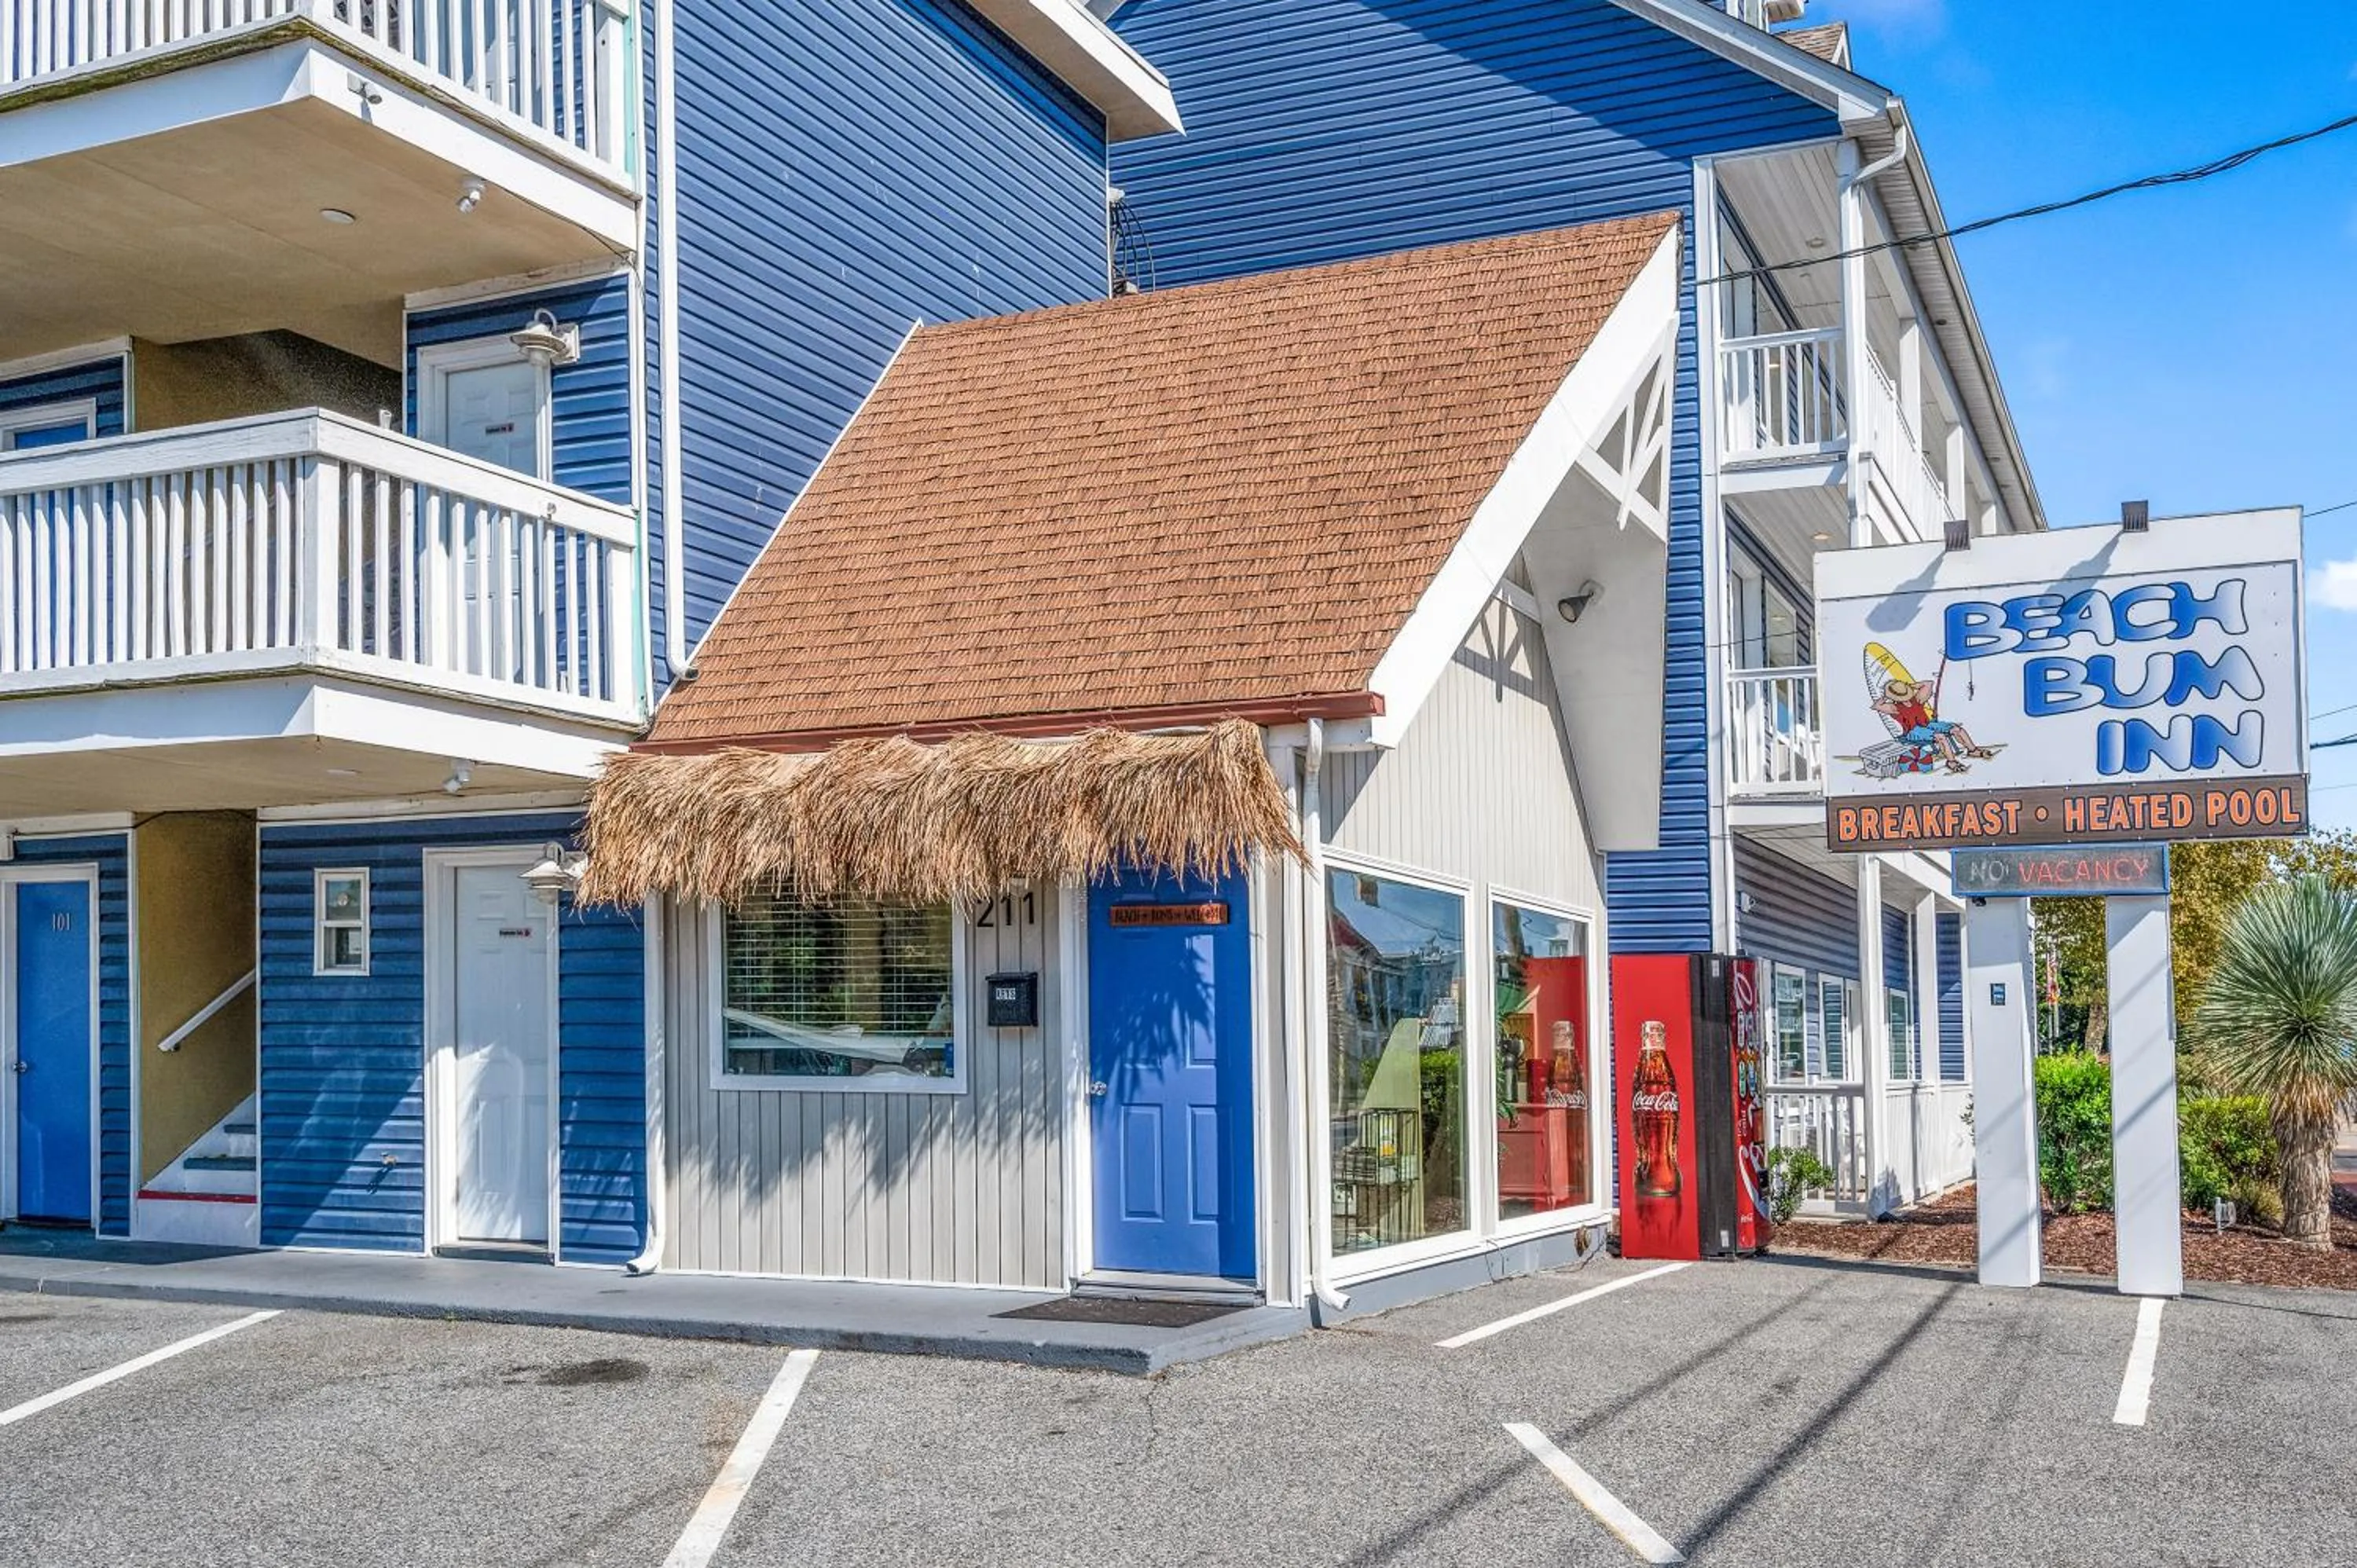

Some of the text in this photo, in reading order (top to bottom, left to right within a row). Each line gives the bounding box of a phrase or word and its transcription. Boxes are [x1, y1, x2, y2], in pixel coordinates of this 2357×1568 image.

[1945, 578, 2249, 661] BEACH
[2024, 645, 2264, 716] BUM
[2097, 710, 2264, 775] INN
[1837, 787, 2301, 842] BREAKFAST HEATED POOL
[1970, 858, 2150, 883] NO VACANCY
[53, 913, 70, 931] 101
[977, 892, 1035, 928] 211
